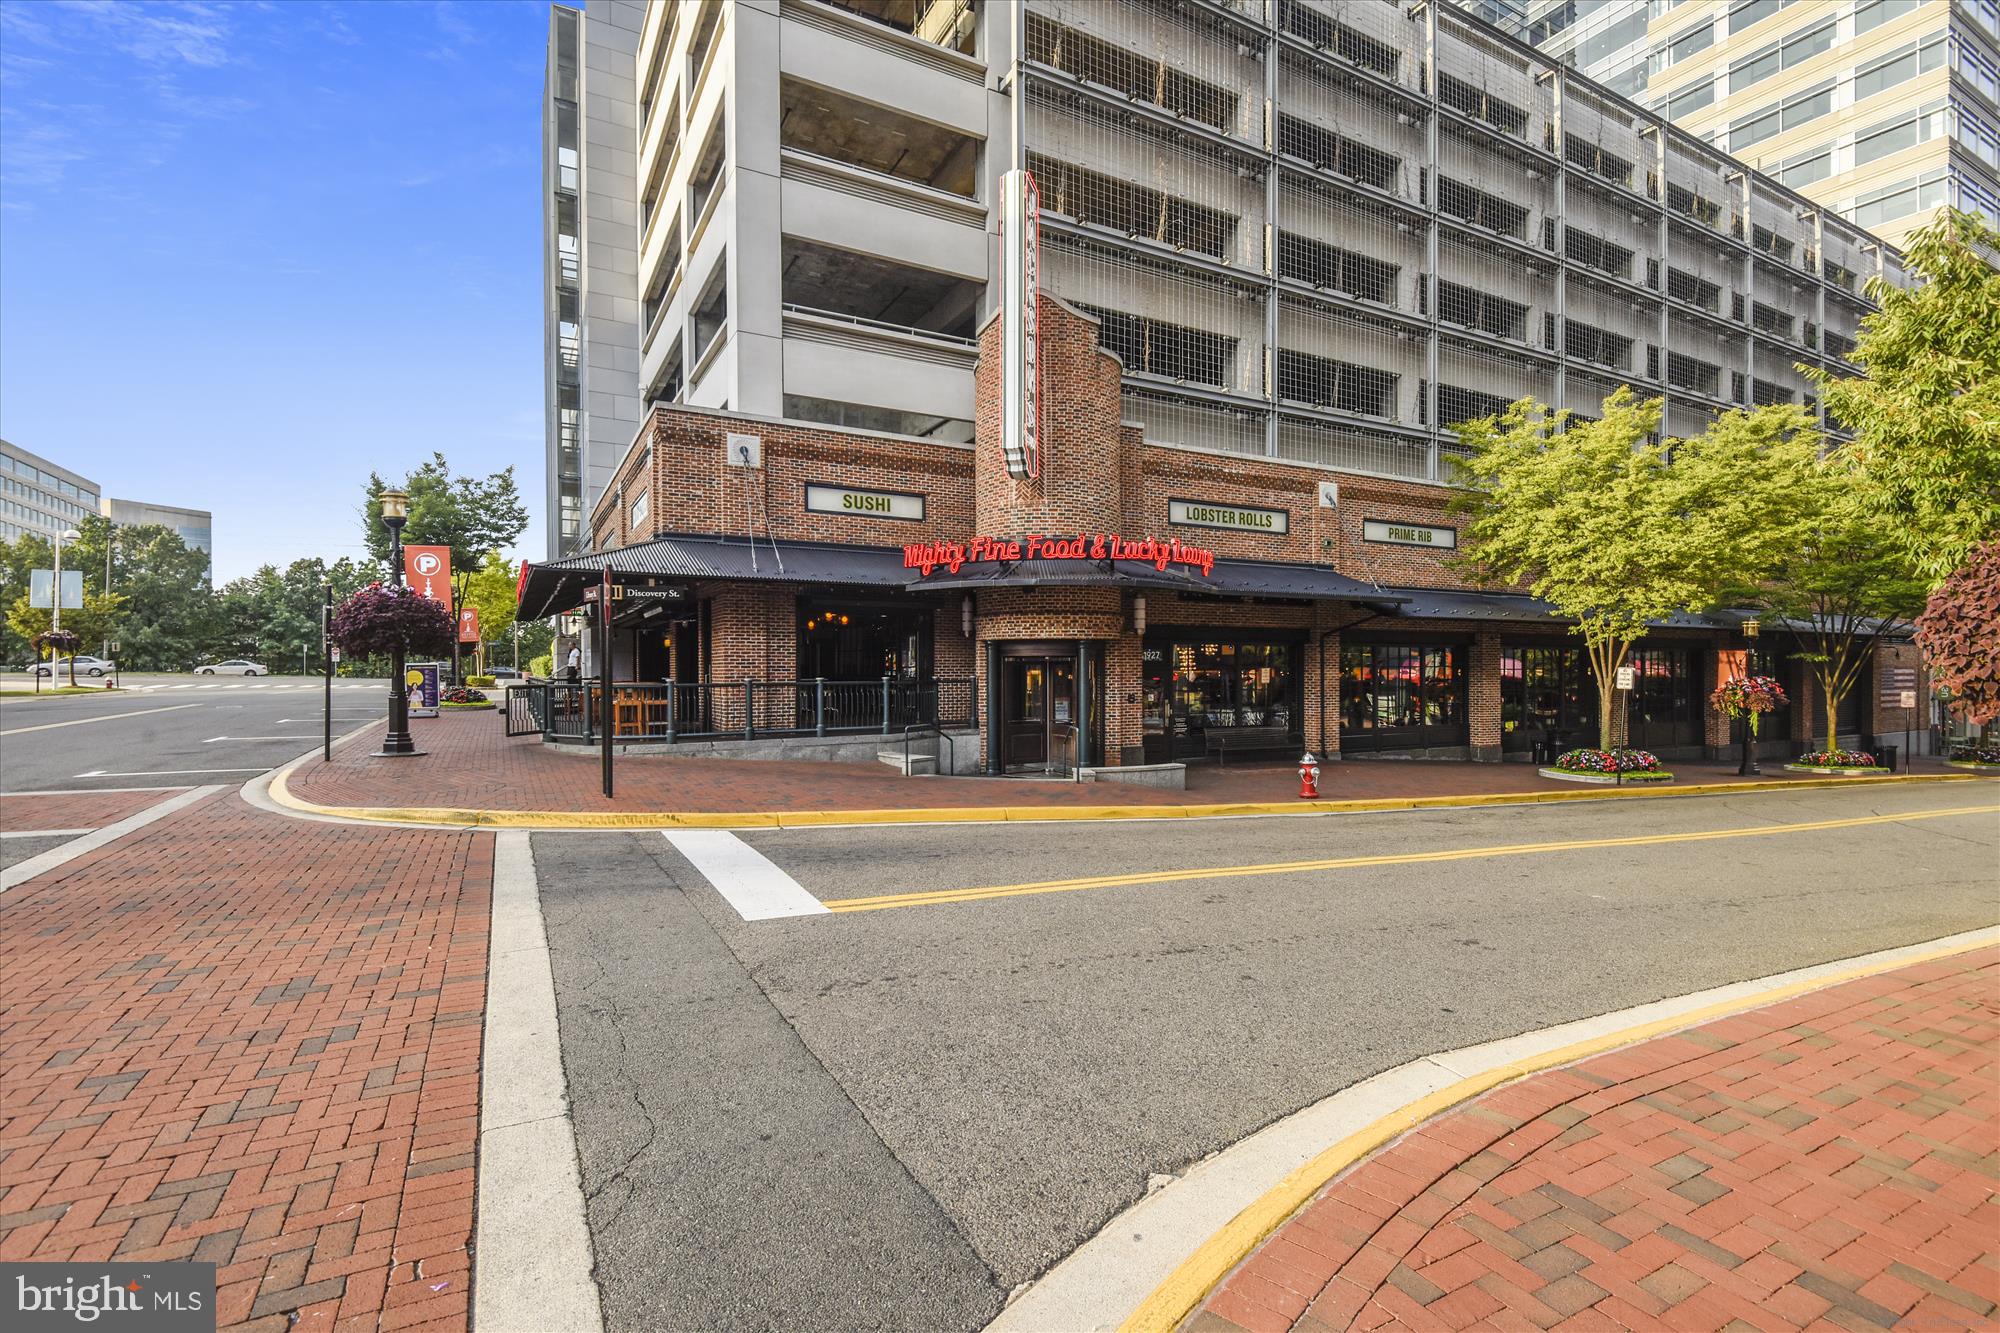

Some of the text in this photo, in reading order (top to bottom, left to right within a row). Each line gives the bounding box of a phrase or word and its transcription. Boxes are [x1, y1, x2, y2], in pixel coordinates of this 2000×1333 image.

[843, 494, 891, 512] SUSHI
[1186, 506, 1273, 528] LOBSTER ROLLS
[1388, 527, 1432, 543] PRIME RIB
[904, 541, 966, 576] Mighty
[970, 536, 1021, 562] Fine
[1026, 533, 1086, 560] Food
[1090, 533, 1107, 559] &
[1109, 534, 1171, 572] Lucky
[420, 556, 437, 573] P
[627, 588, 680, 600] Discovery St.
[515, 689, 527, 698] EXIT
